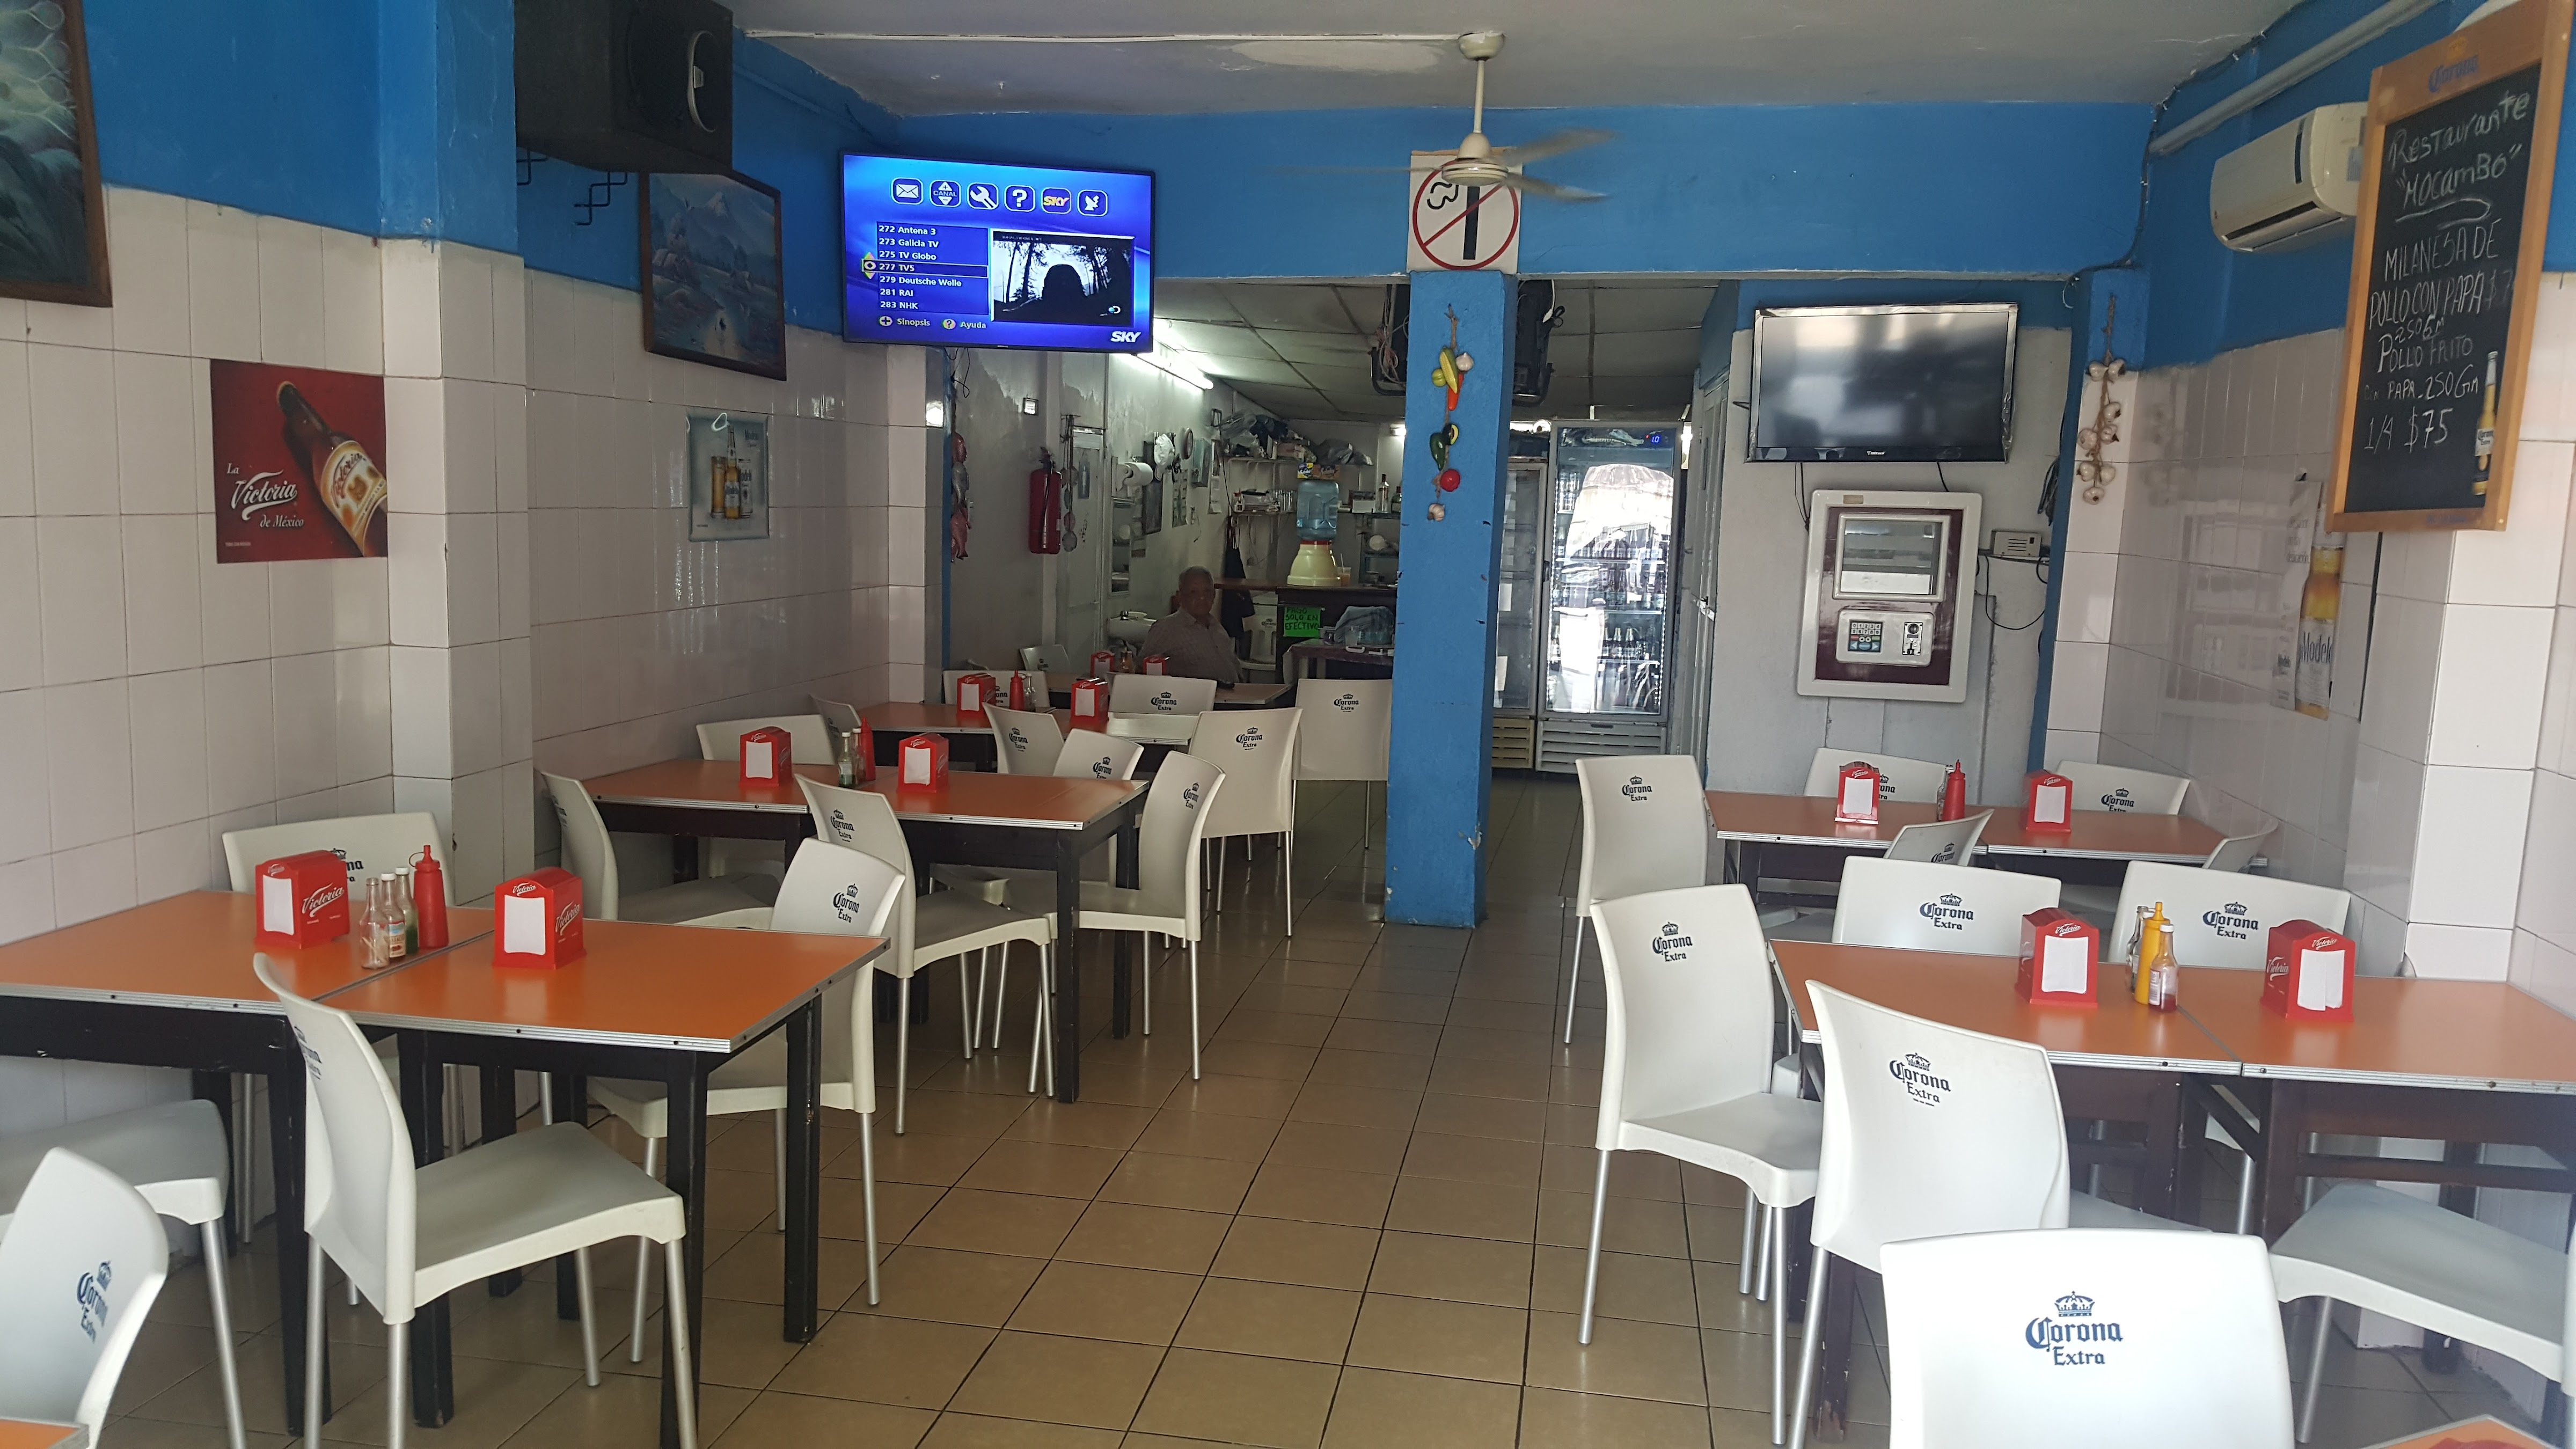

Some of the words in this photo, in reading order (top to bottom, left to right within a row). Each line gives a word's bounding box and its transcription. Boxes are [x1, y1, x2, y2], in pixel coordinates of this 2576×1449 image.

[933, 189, 957, 198] CANAL
[1043, 195, 1070, 207] SKY
[879, 225, 895, 233] 272
[898, 226, 928, 235] Antena
[879, 238, 895, 246] 273
[898, 239, 926, 247] Galicia
[928, 240, 939, 248] TV
[2473, 218, 2502, 259] DE
[879, 250, 895, 259] 275
[898, 251, 910, 259] TV
[911, 252, 936, 261] Globo
[879, 263, 895, 271] 277
[898, 264, 914, 272] TV5
[880, 275, 896, 284] 279
[898, 277, 937, 286] Deutsche
[939, 279, 962, 287] Welle
[880, 288, 896, 296] 281
[880, 301, 896, 309] 283
[899, 302, 918, 310] NHK
[2369, 287, 2410, 330] POLLO
[2412, 280, 2441, 317] CON
[2443, 270, 2485, 315] PAPA
[897, 318, 931, 327] Sinopsis
[960, 320, 986, 330] Ayuda
[1110, 331, 1141, 343] SKY
[2388, 378, 2415, 400] PAPA
[2404, 406, 2453, 454] $75
[227, 463, 239, 474] La
[231, 470, 298, 521] Victoria
[260, 514, 270, 528] de
[273, 514, 304, 528] México
[1151, 697, 1177, 706] Corona
[1334, 698, 1359, 707] Corona
[1009, 733, 1028, 743] Corona
[1236, 733, 1263, 743] Corona
[1093, 762, 1112, 775] Corona
[1183, 787, 1199, 802] Corona
[1622, 784, 1652, 796] Corona
[1879, 785, 1896, 793] ona
[2101, 794, 2134, 807] Corona
[830, 816, 855, 831] Corona
[838, 829, 852, 839] Extra
[513, 882, 537, 896] Victoria
[301, 882, 345, 918] Victoria
[833, 892, 860, 913] Corona
[838, 908, 852, 923] Extra
[1919, 902, 1974, 920] Corona
[555, 900, 581, 936] Victoria
[1934, 917, 1963, 930] Extra
[2202, 910, 2259, 931] Corona
[2055, 923, 2082, 936] Victoria
[2216, 926, 2246, 940] Extra
[1652, 935, 1693, 955] Corona
[2312, 936, 2337, 950] Victoria
[1664, 951, 1687, 962] Extra
[2266, 956, 2289, 981] Victoria
[1889, 1060, 1951, 1092] Corona
[1906, 1081, 1940, 1103] Extra
[2025, 1316, 2124, 1352] Corona
[2052, 1345, 2106, 1366] Extra
